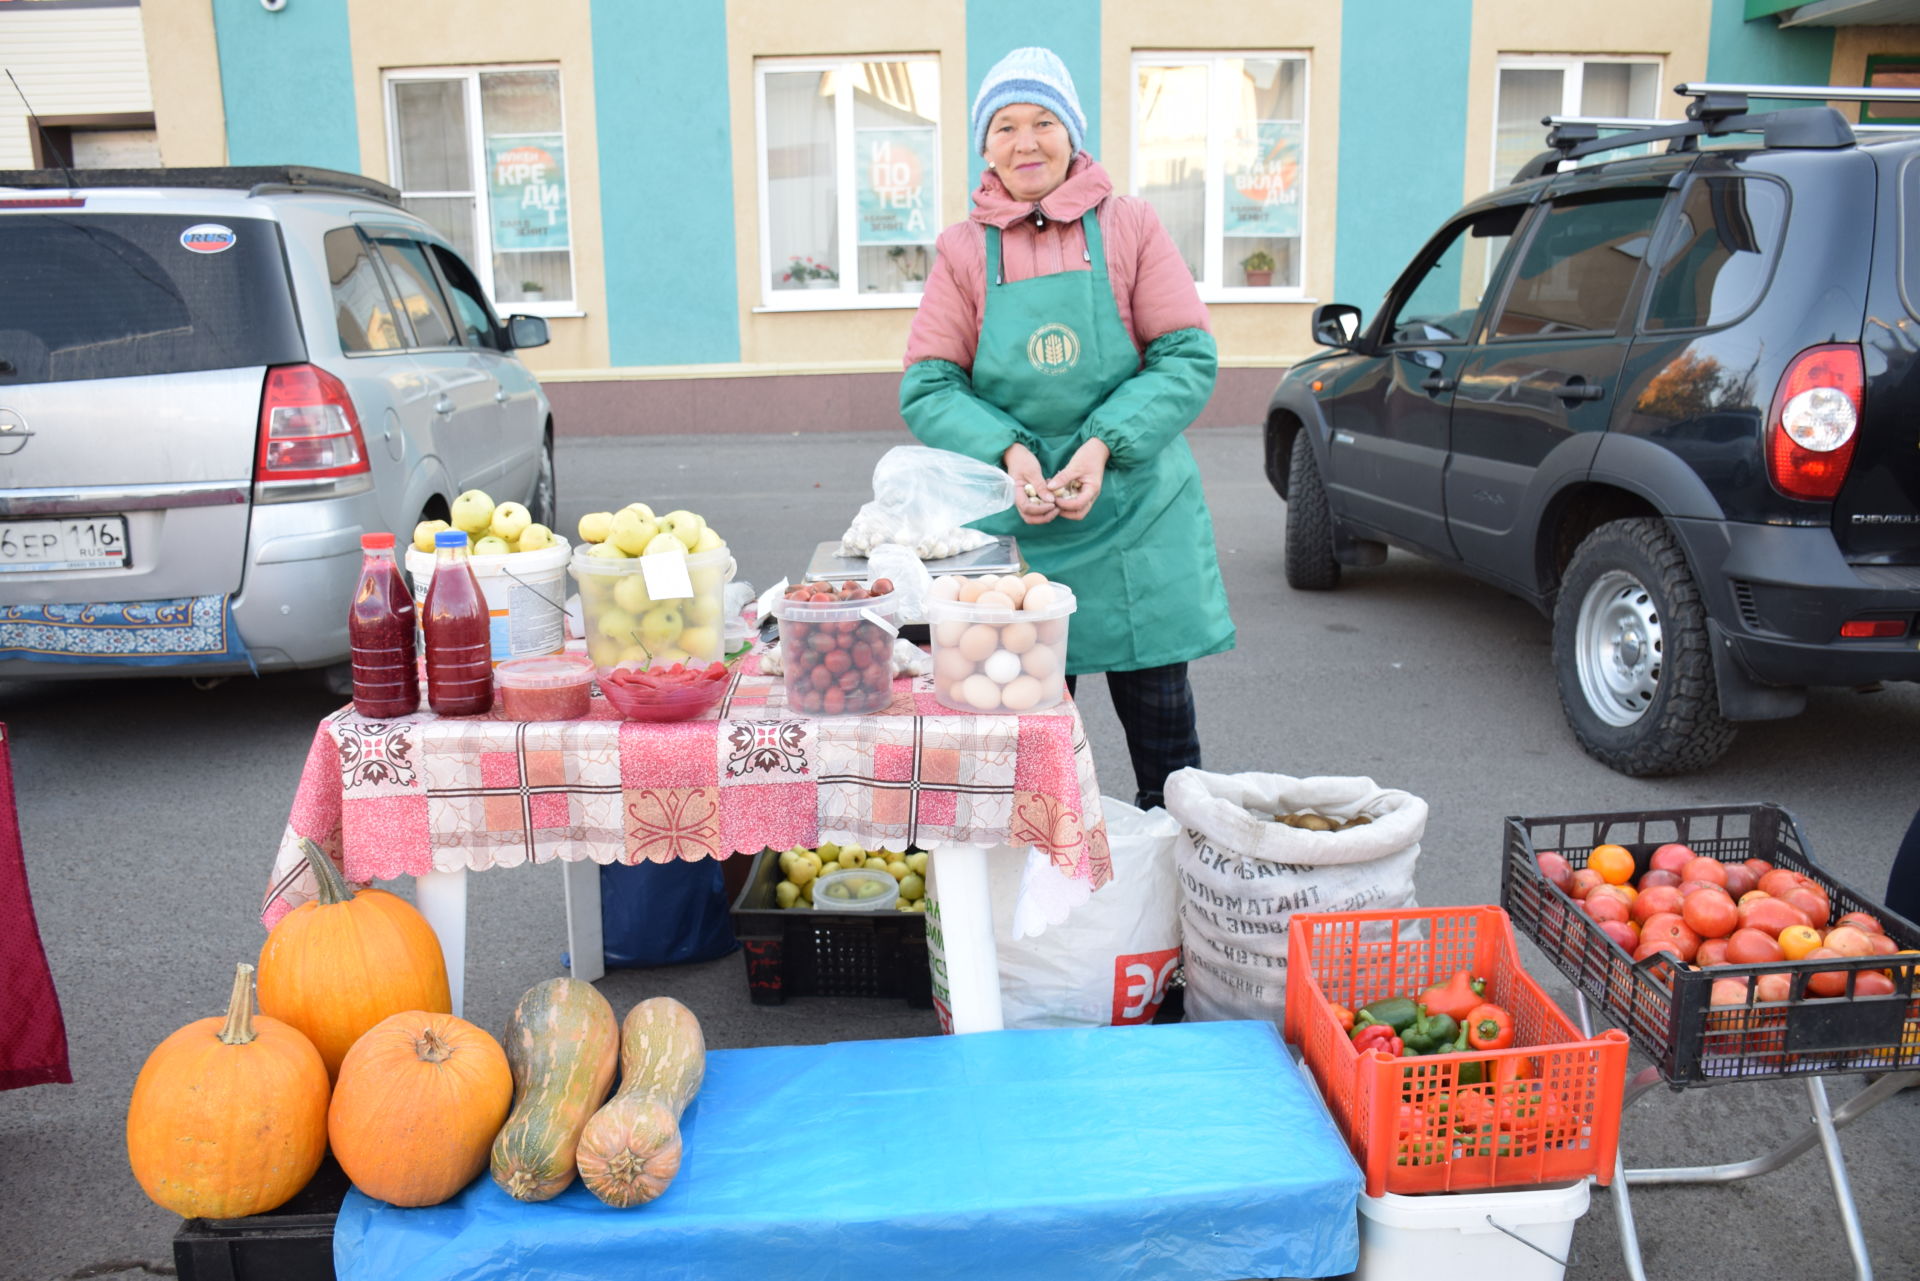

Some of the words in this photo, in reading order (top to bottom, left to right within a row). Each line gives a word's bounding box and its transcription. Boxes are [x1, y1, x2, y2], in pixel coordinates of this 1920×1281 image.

[872, 161, 911, 187] ПО
[190, 232, 228, 243] RUS
[79, 547, 105, 557] RUS
